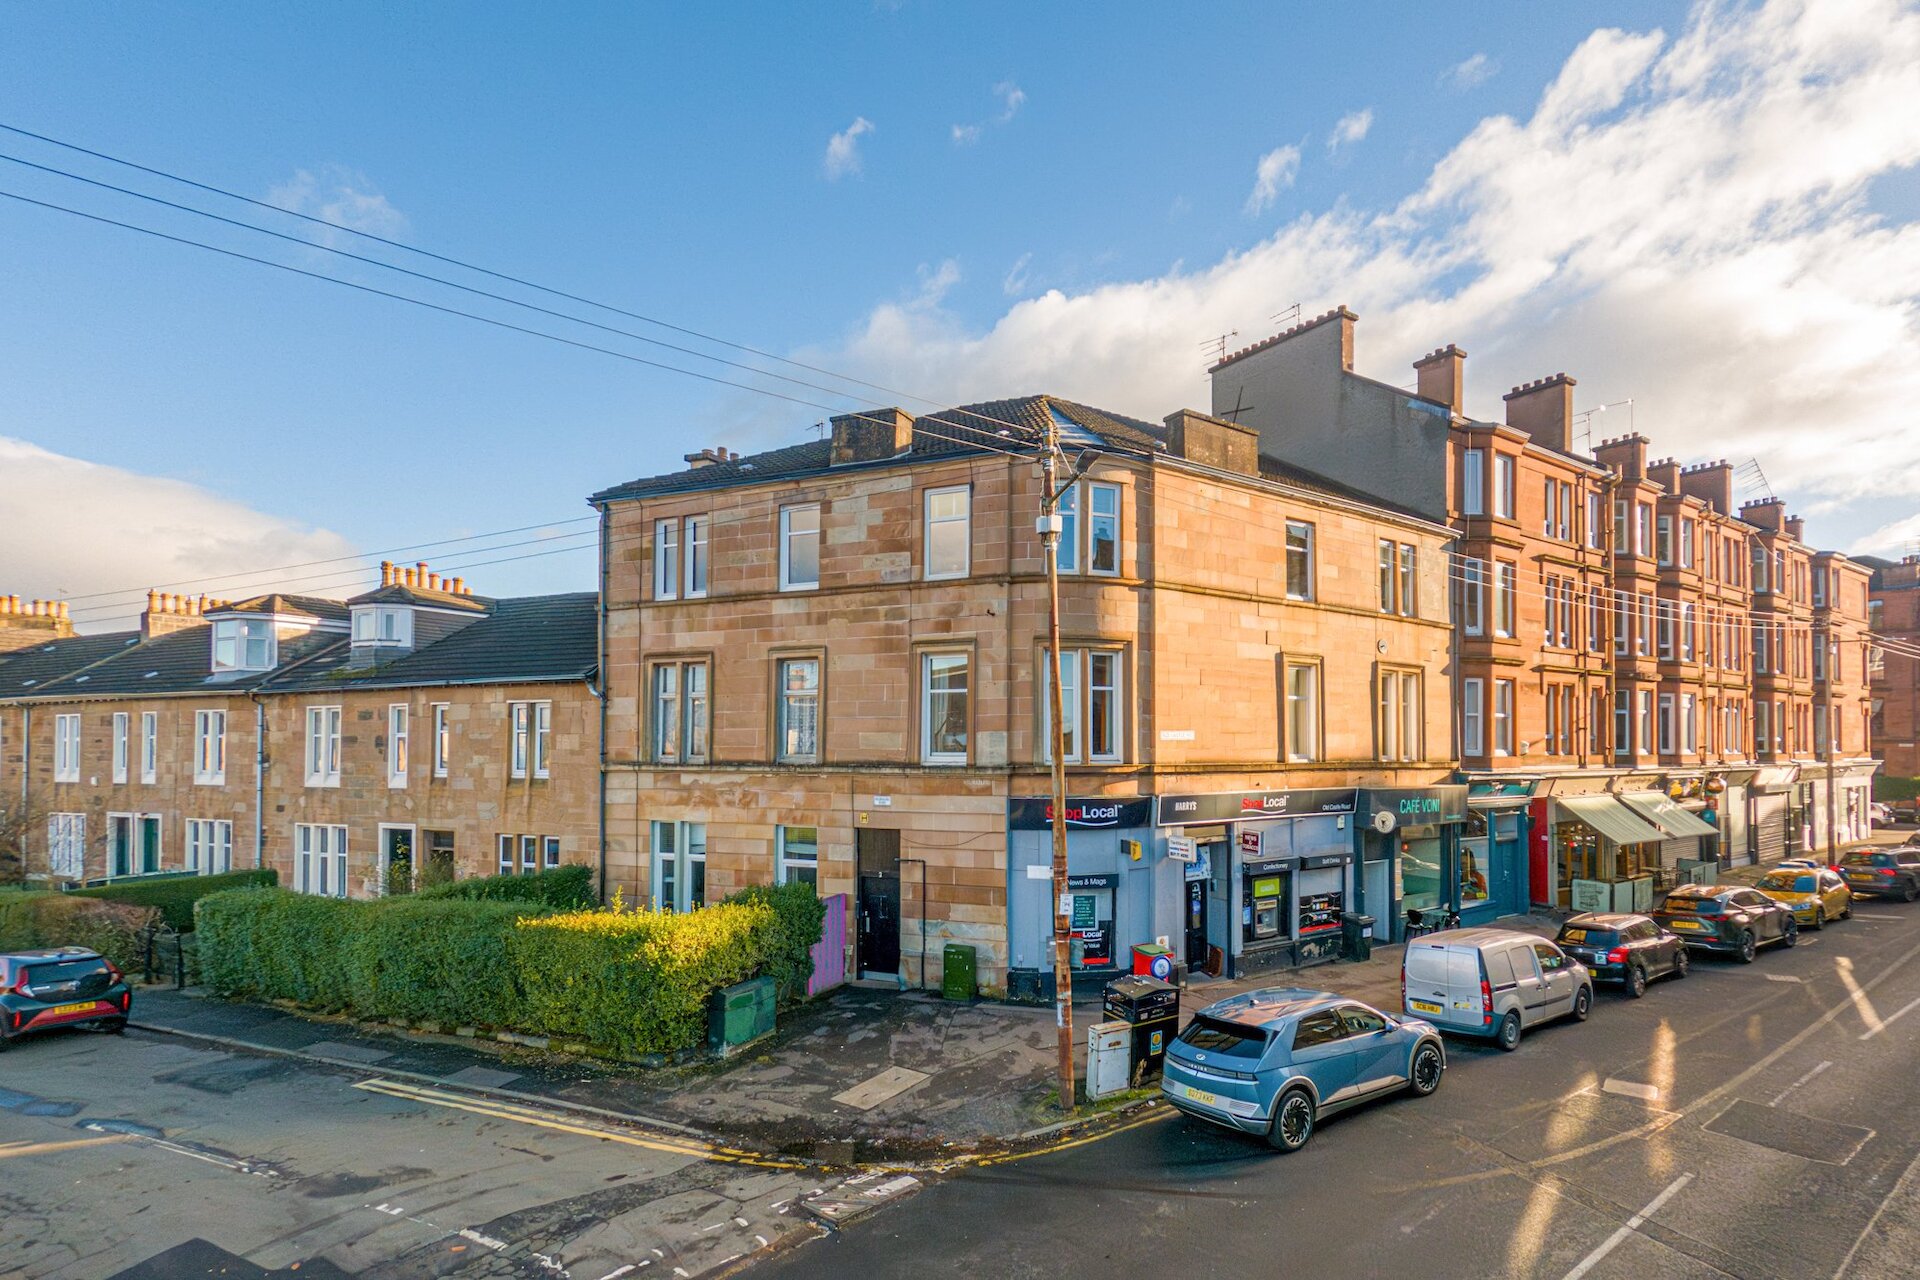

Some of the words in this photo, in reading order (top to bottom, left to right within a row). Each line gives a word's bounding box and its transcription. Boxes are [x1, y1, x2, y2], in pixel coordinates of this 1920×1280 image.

[1045, 804, 1119, 820] SopLocal
[1400, 797, 1420, 814] CAFÉ
[1421, 798, 1440, 813] VONI
[1090, 878, 1107, 886] Mags
